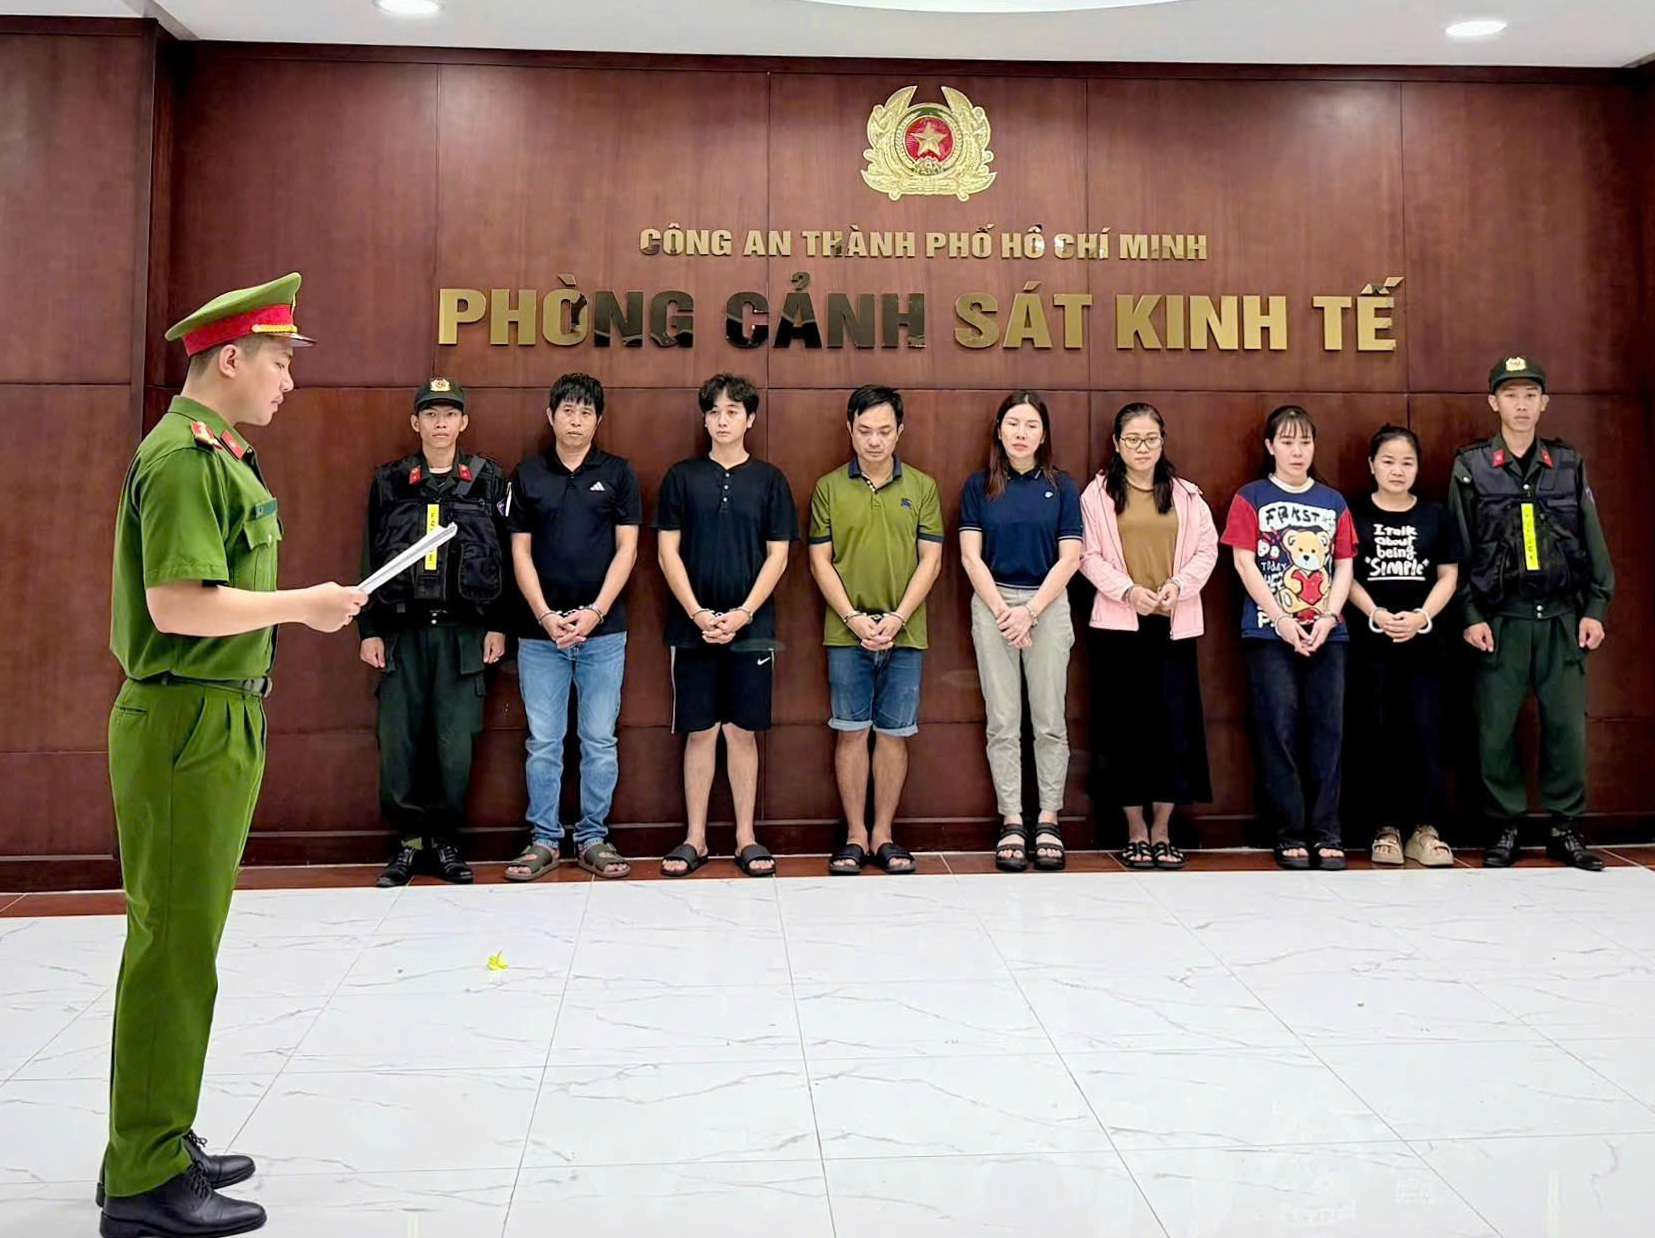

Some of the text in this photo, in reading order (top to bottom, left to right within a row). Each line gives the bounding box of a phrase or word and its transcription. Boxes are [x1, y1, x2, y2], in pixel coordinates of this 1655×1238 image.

[639, 222, 1207, 261] CÔNG AN THÀNH PHỐ HỒ CHÍ MINH
[438, 271, 1404, 352] PHÒNG CẢNH SÁT KINH TẾ
